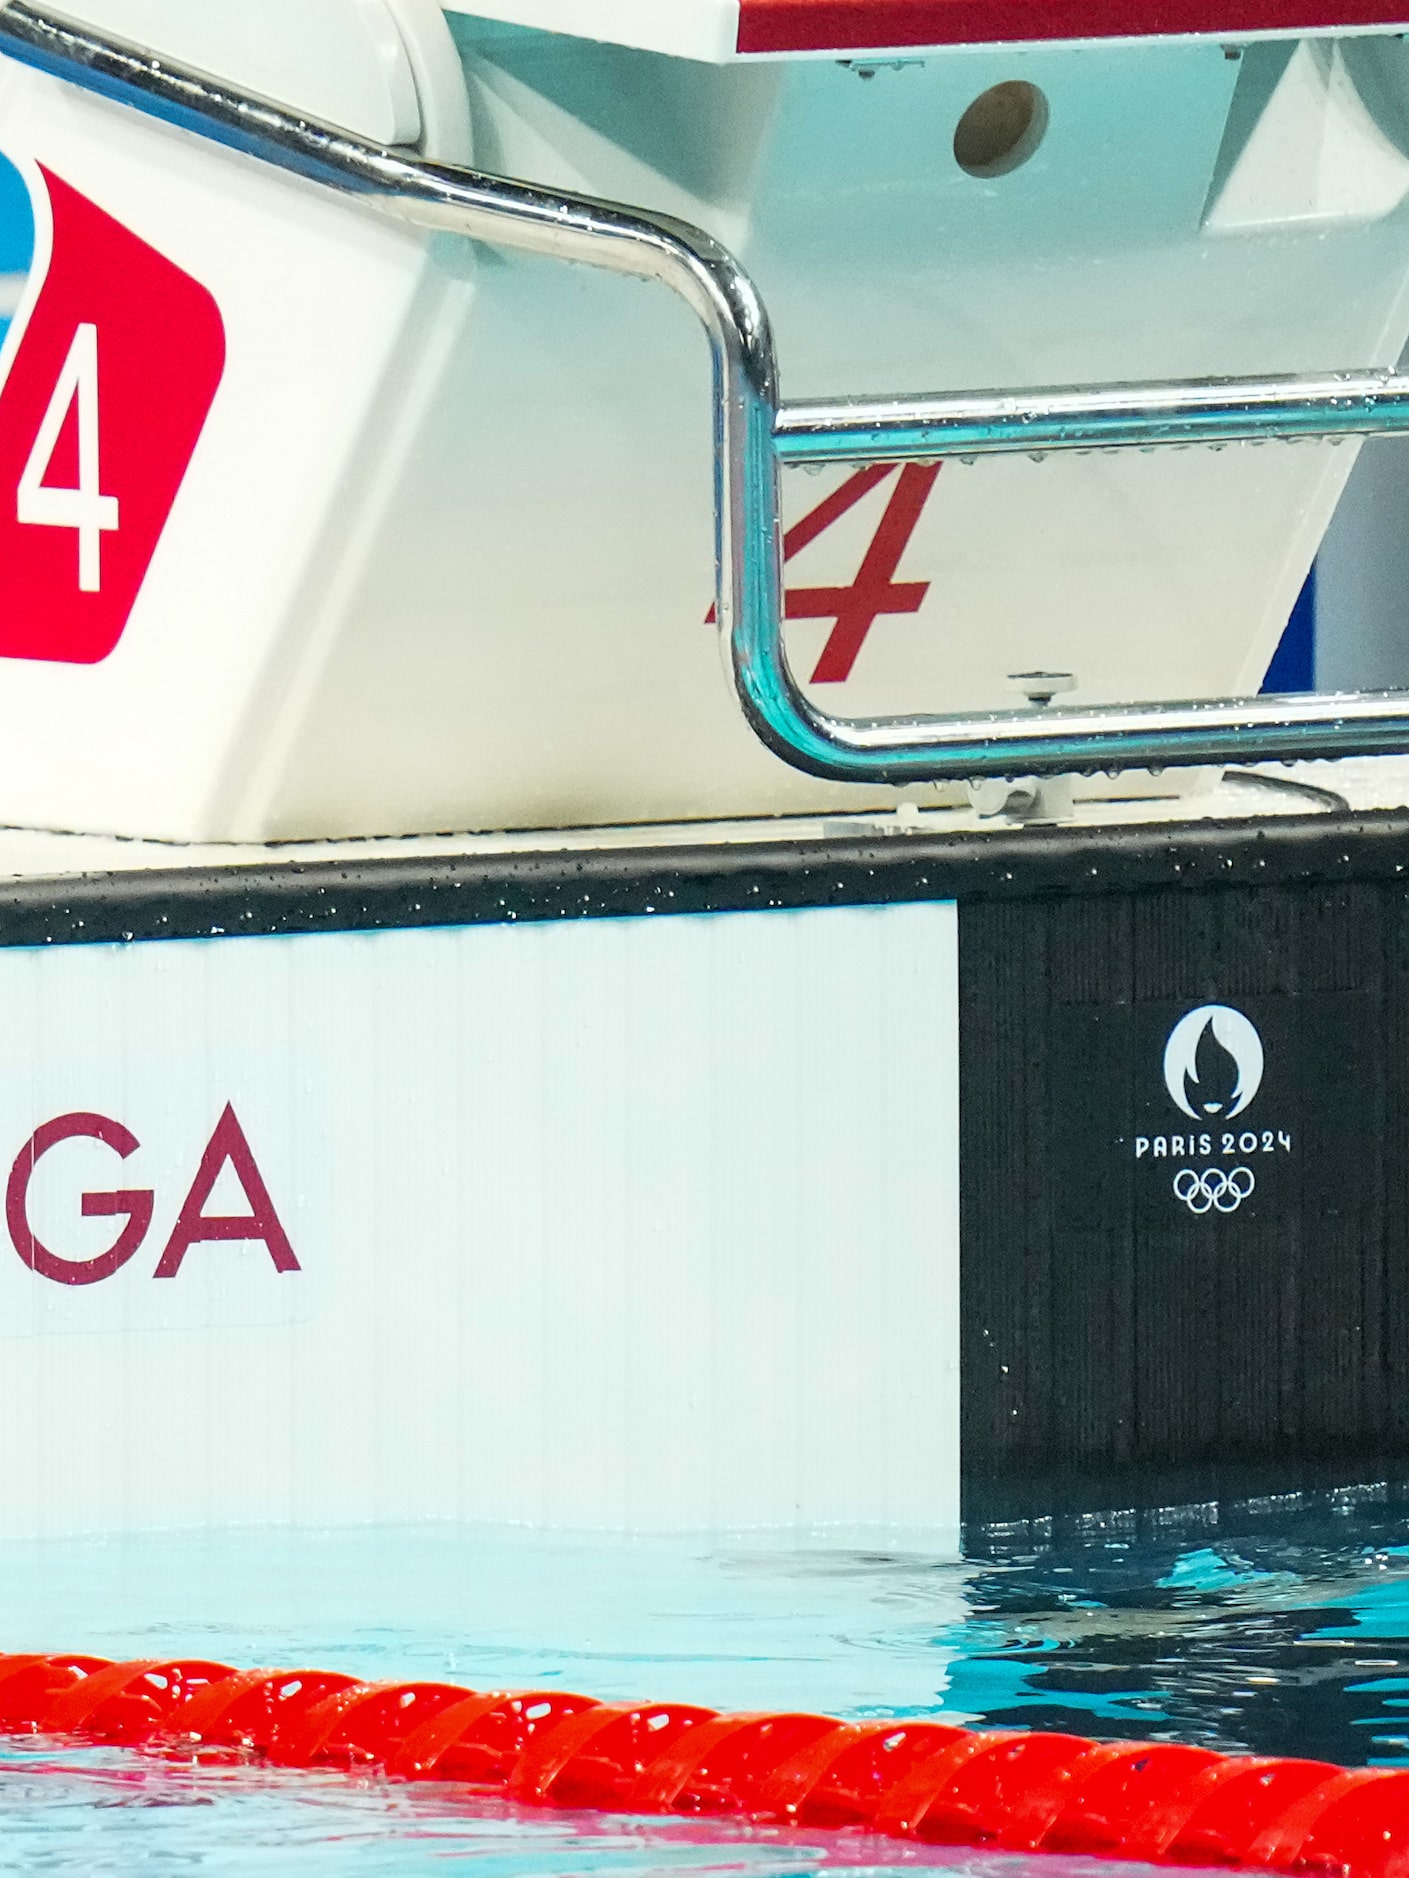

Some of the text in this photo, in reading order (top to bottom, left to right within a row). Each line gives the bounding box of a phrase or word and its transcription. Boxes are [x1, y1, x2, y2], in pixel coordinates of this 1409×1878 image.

[17, 322, 119, 592] 4
[704, 460, 944, 684] 4
[1135, 1130, 1292, 1159] PARIS 2024
